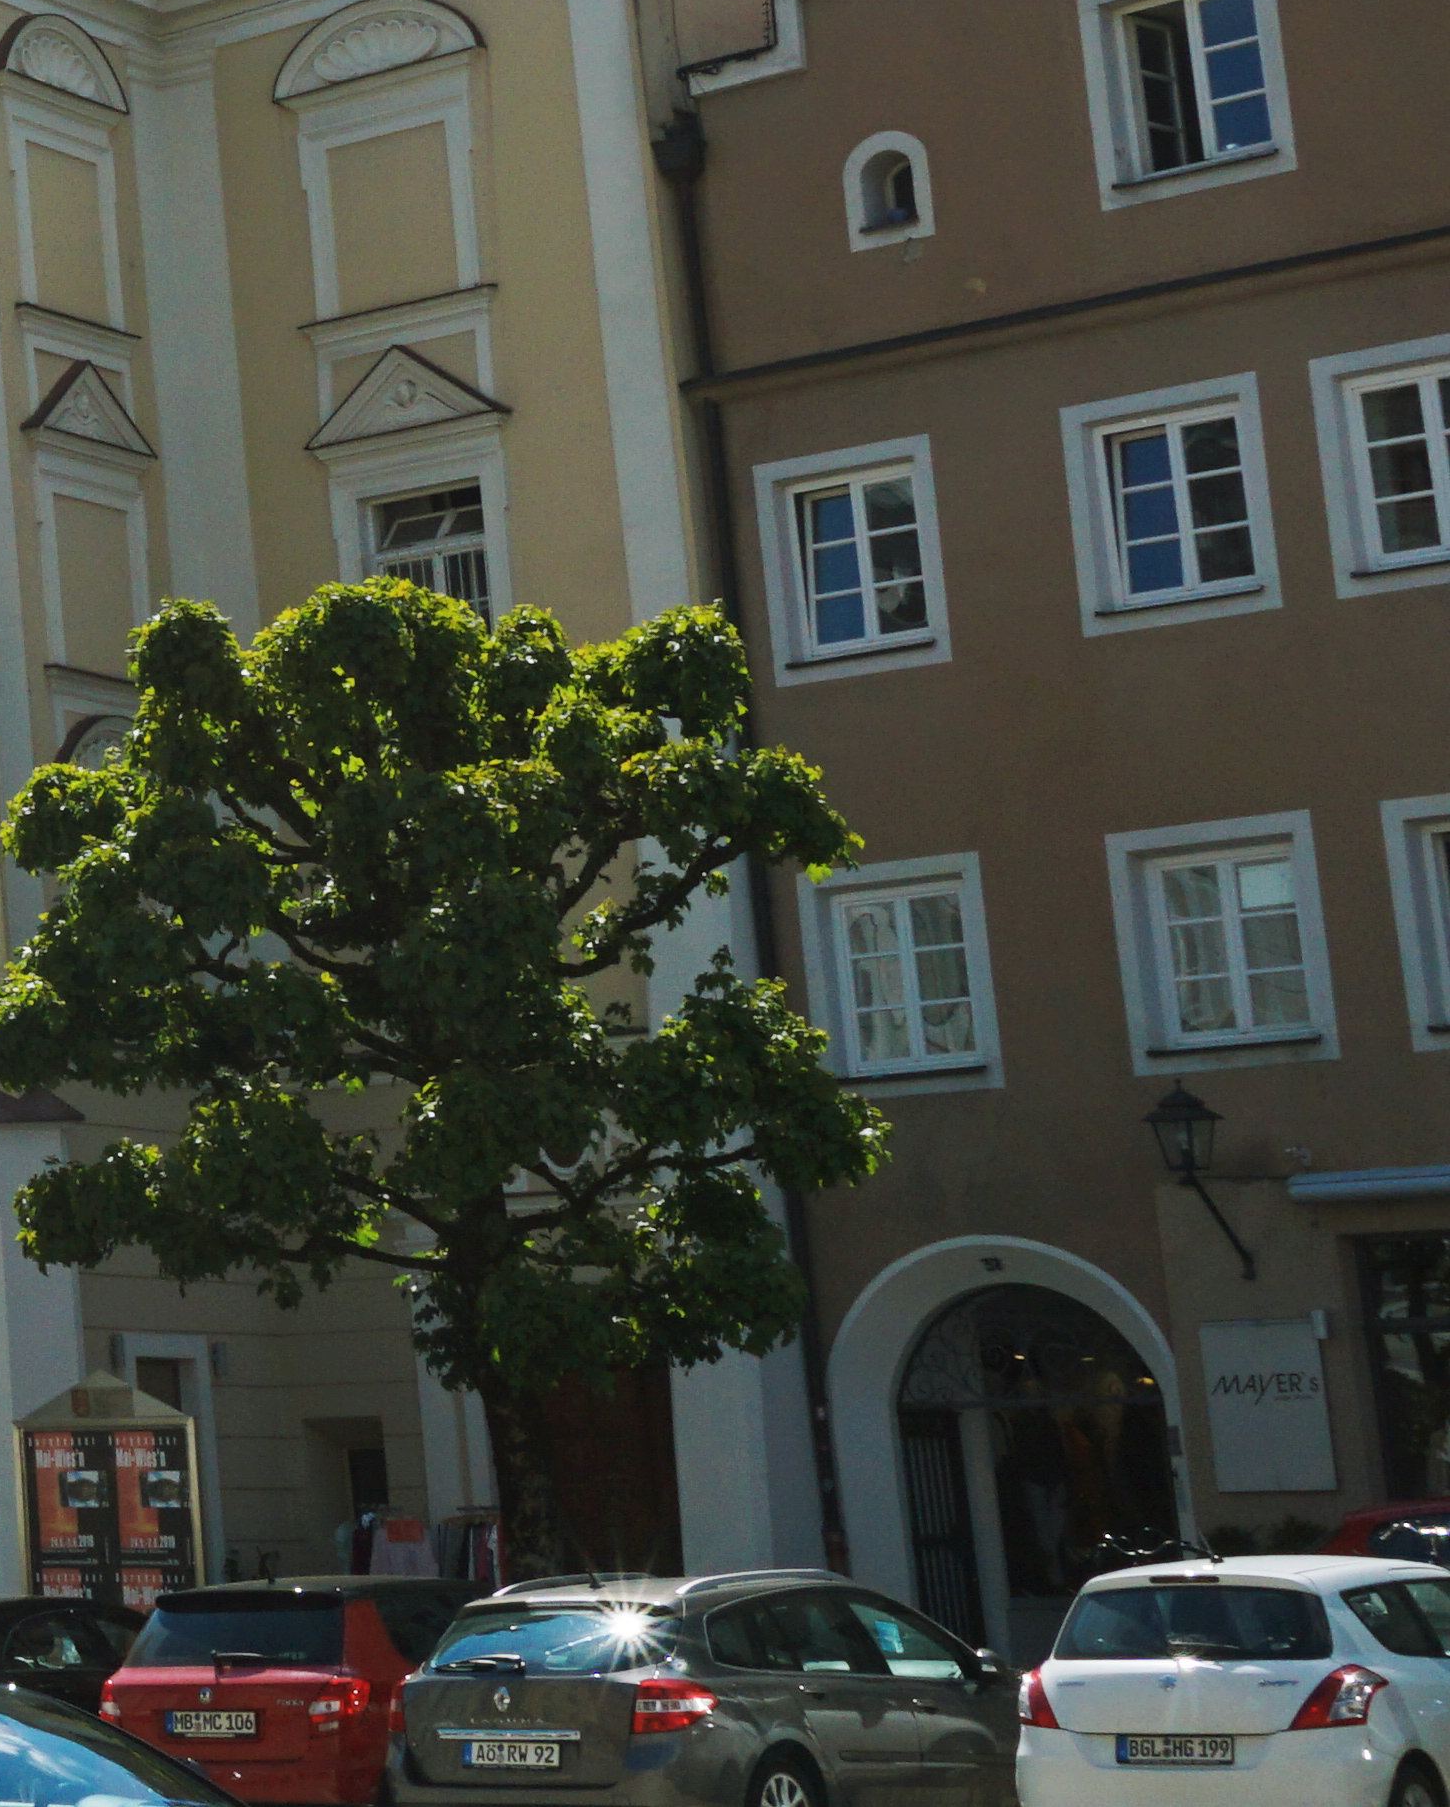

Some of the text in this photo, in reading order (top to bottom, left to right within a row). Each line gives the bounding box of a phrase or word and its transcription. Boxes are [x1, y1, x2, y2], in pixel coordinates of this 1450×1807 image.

[174, 1713, 253, 1731] MB MC 106
[476, 1744, 555, 1763] AÖ RW 92
[1129, 1741, 1229, 1758] BGL HG 199
